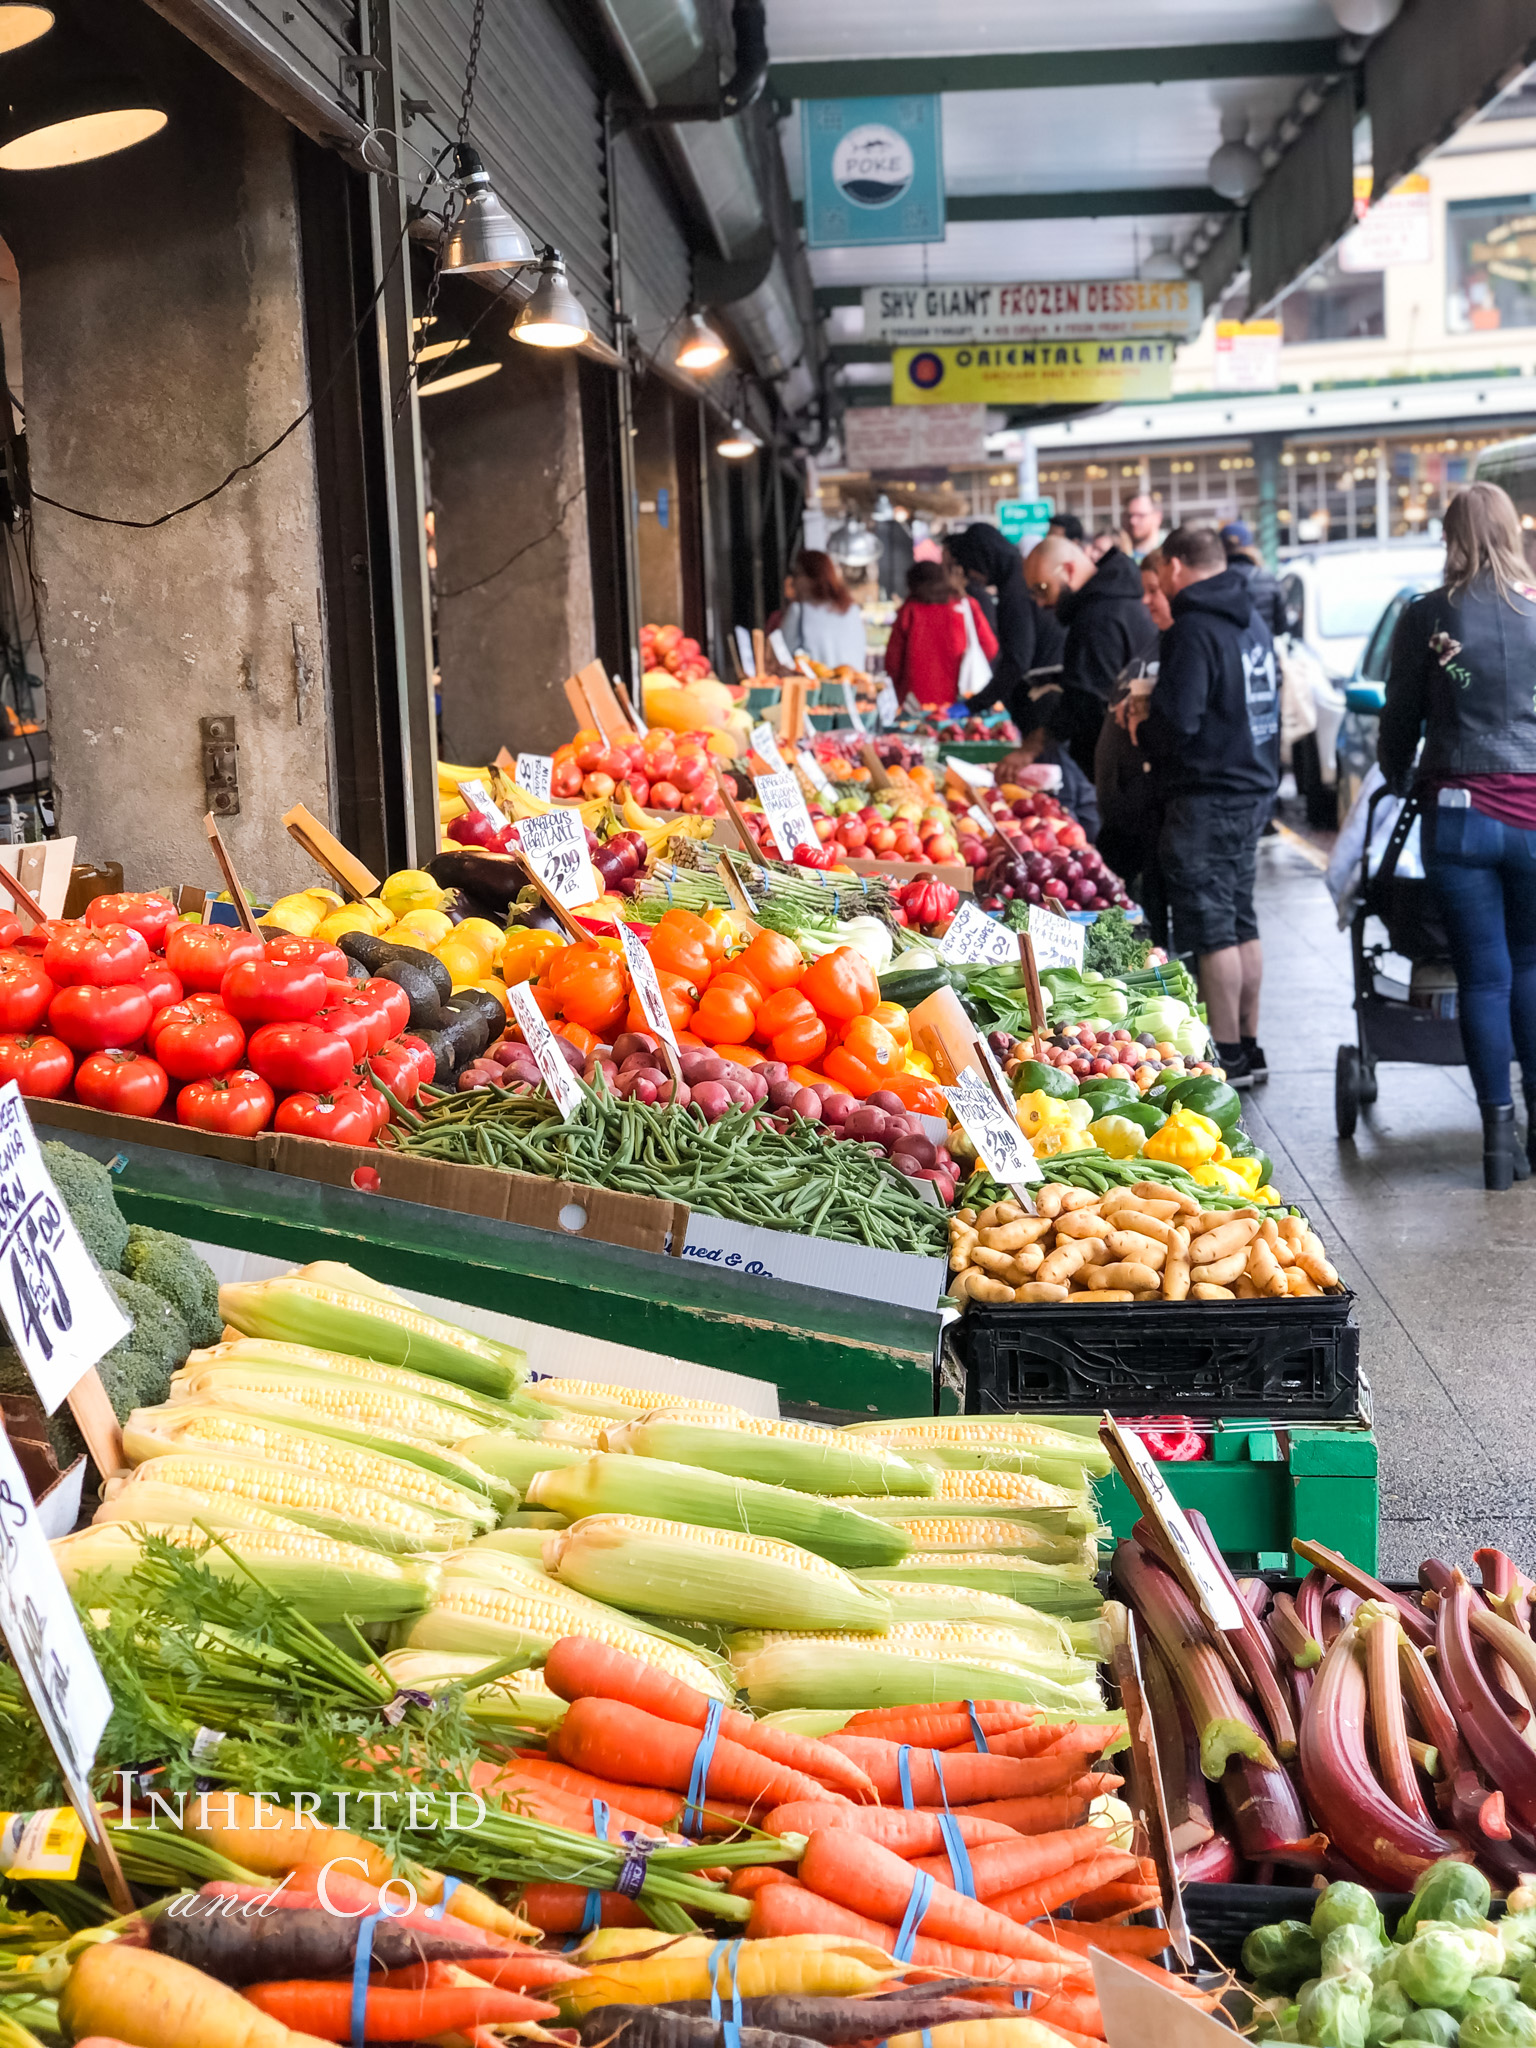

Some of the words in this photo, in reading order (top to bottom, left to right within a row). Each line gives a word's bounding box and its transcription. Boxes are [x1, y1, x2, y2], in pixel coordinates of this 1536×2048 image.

[845, 155, 903, 174] POKE
[880, 290, 919, 320] SHY
[926, 287, 991, 317] GIANT
[1000, 284, 1080, 316] FROZEN
[1087, 281, 1190, 314] DESSERTS
[956, 347, 1082, 367] ORIENTAL
[1096, 344, 1166, 362] MART
[522, 811, 573, 833] GORGEOUS
[523, 824, 576, 851] EGGPLANT
[942, 933, 956, 954] NEW
[957, 927, 979, 956] LOCAL
[973, 920, 996, 950] SCAPES
[682, 1245, 723, 1261] ned
[725, 1253, 742, 1266] &
